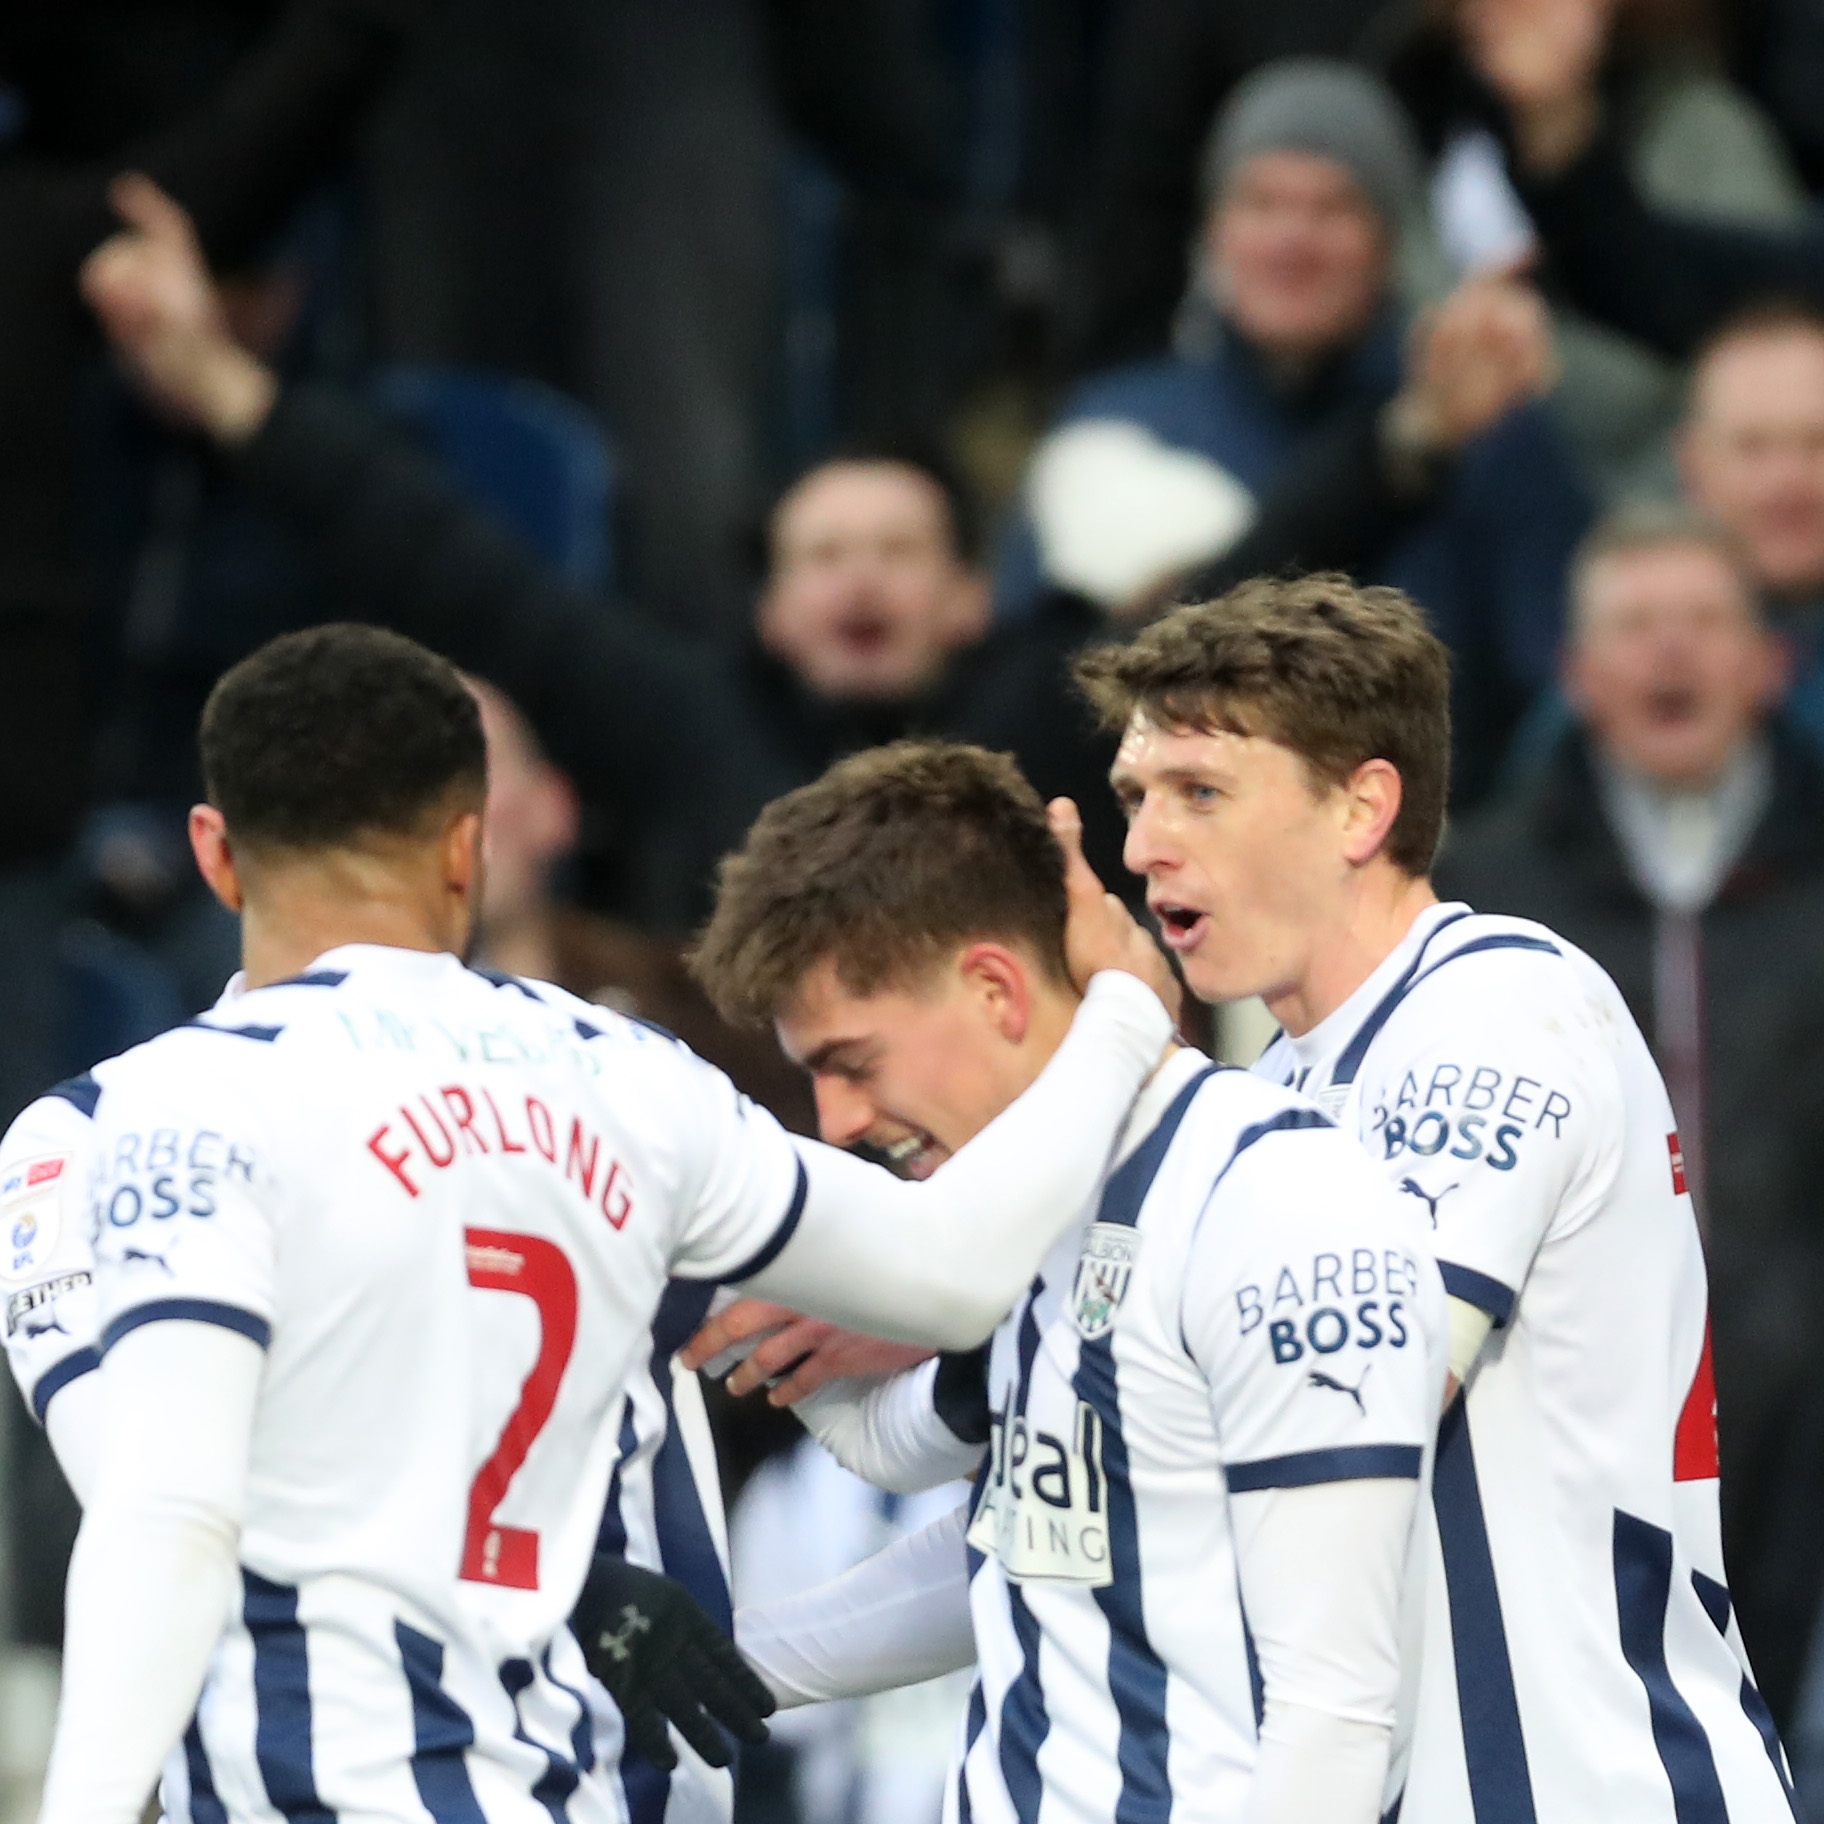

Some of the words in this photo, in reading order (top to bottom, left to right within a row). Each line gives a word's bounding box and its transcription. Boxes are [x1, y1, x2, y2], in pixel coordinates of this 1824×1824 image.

[366, 1083, 636, 1232] FURLONG
[1384, 1110, 1524, 1172] BOSS
[1269, 1301, 1408, 1365] BOSS
[453, 1226, 580, 1592] 2
